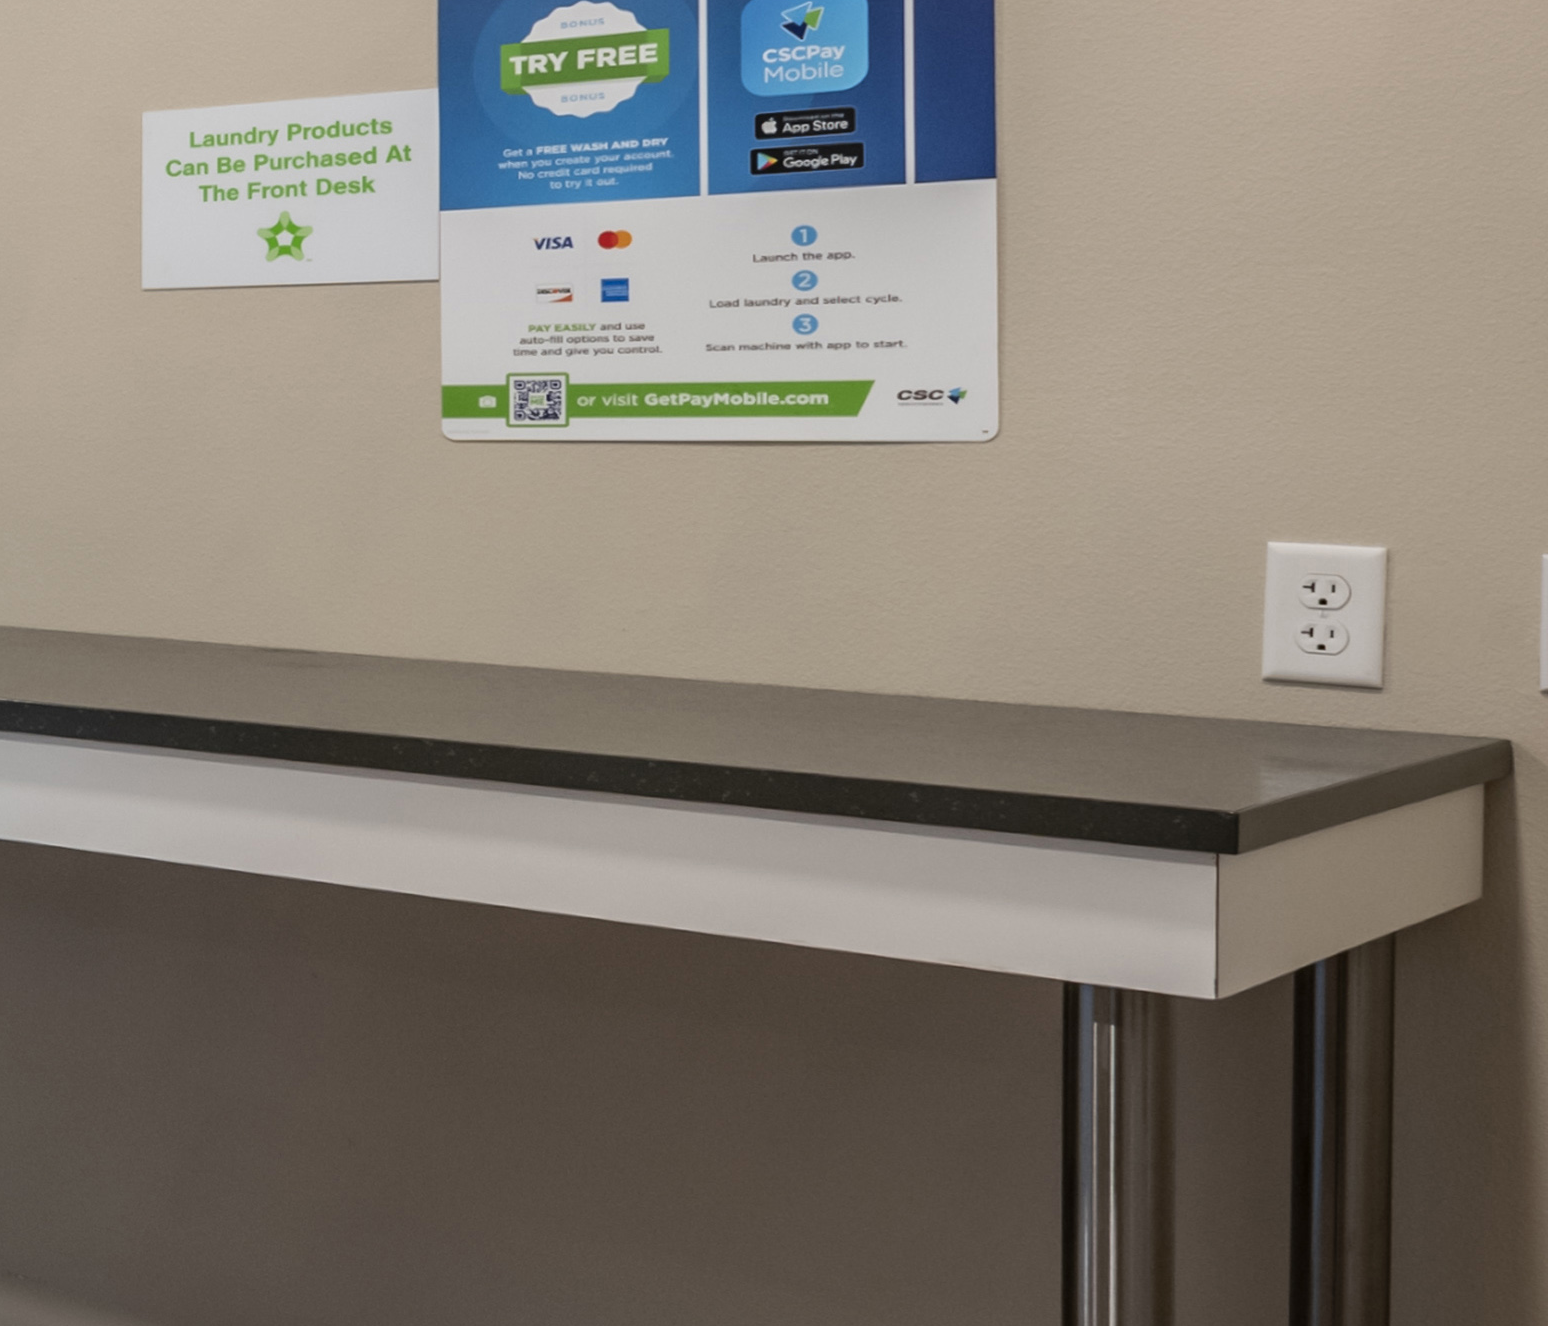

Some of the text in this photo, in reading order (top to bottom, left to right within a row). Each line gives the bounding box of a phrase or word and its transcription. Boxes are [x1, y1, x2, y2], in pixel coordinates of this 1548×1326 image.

[560, 18, 605, 29] BONUS
[509, 44, 658, 75] TRY FREE
[762, 45, 845, 63] CSCPay
[764, 61, 844, 83] Mobile
[561, 92, 605, 103] BONUS
[189, 119, 392, 148] Laundry Products
[782, 120, 848, 134] App Store
[503, 148, 523, 157] Get
[536, 145, 567, 155] FREE
[571, 142, 608, 152] WASH
[611, 140, 639, 149] AND
[642, 138, 668, 147] DRY
[166, 144, 411, 177] Can Be Purchased At
[498, 160, 528, 169] when
[531, 159, 552, 169] you
[555, 156, 590, 166] create
[595, 153, 620, 164] your
[783, 154, 857, 169] Google Play
[518, 163, 653, 179] No credit card required
[199, 176, 375, 202] The Front Desk
[550, 181, 562, 189] to
[565, 180, 581, 189] try
[586, 179, 593, 187] it
[800, 229, 807, 243] 1
[533, 237, 573, 250] VISA
[752, 251, 855, 263] Launch the app.
[799, 273, 812, 287] 2
[710, 295, 902, 308] Load laundry and select cycle.
[799, 318, 811, 332] 3
[520, 336, 563, 344] auto-fill
[566, 335, 609, 344] options
[706, 344, 735, 352] Scan
[739, 342, 791, 351] machine
[796, 342, 823, 350] with
[827, 342, 851, 351] app
[874, 340, 907, 348] start.
[513, 348, 537, 356] time
[565, 348, 589, 357] give
[593, 348, 613, 356] you
[618, 346, 662, 354] control.
[577, 390, 830, 410] or visit GetPayMobile.com
[896, 389, 944, 401] CSC
